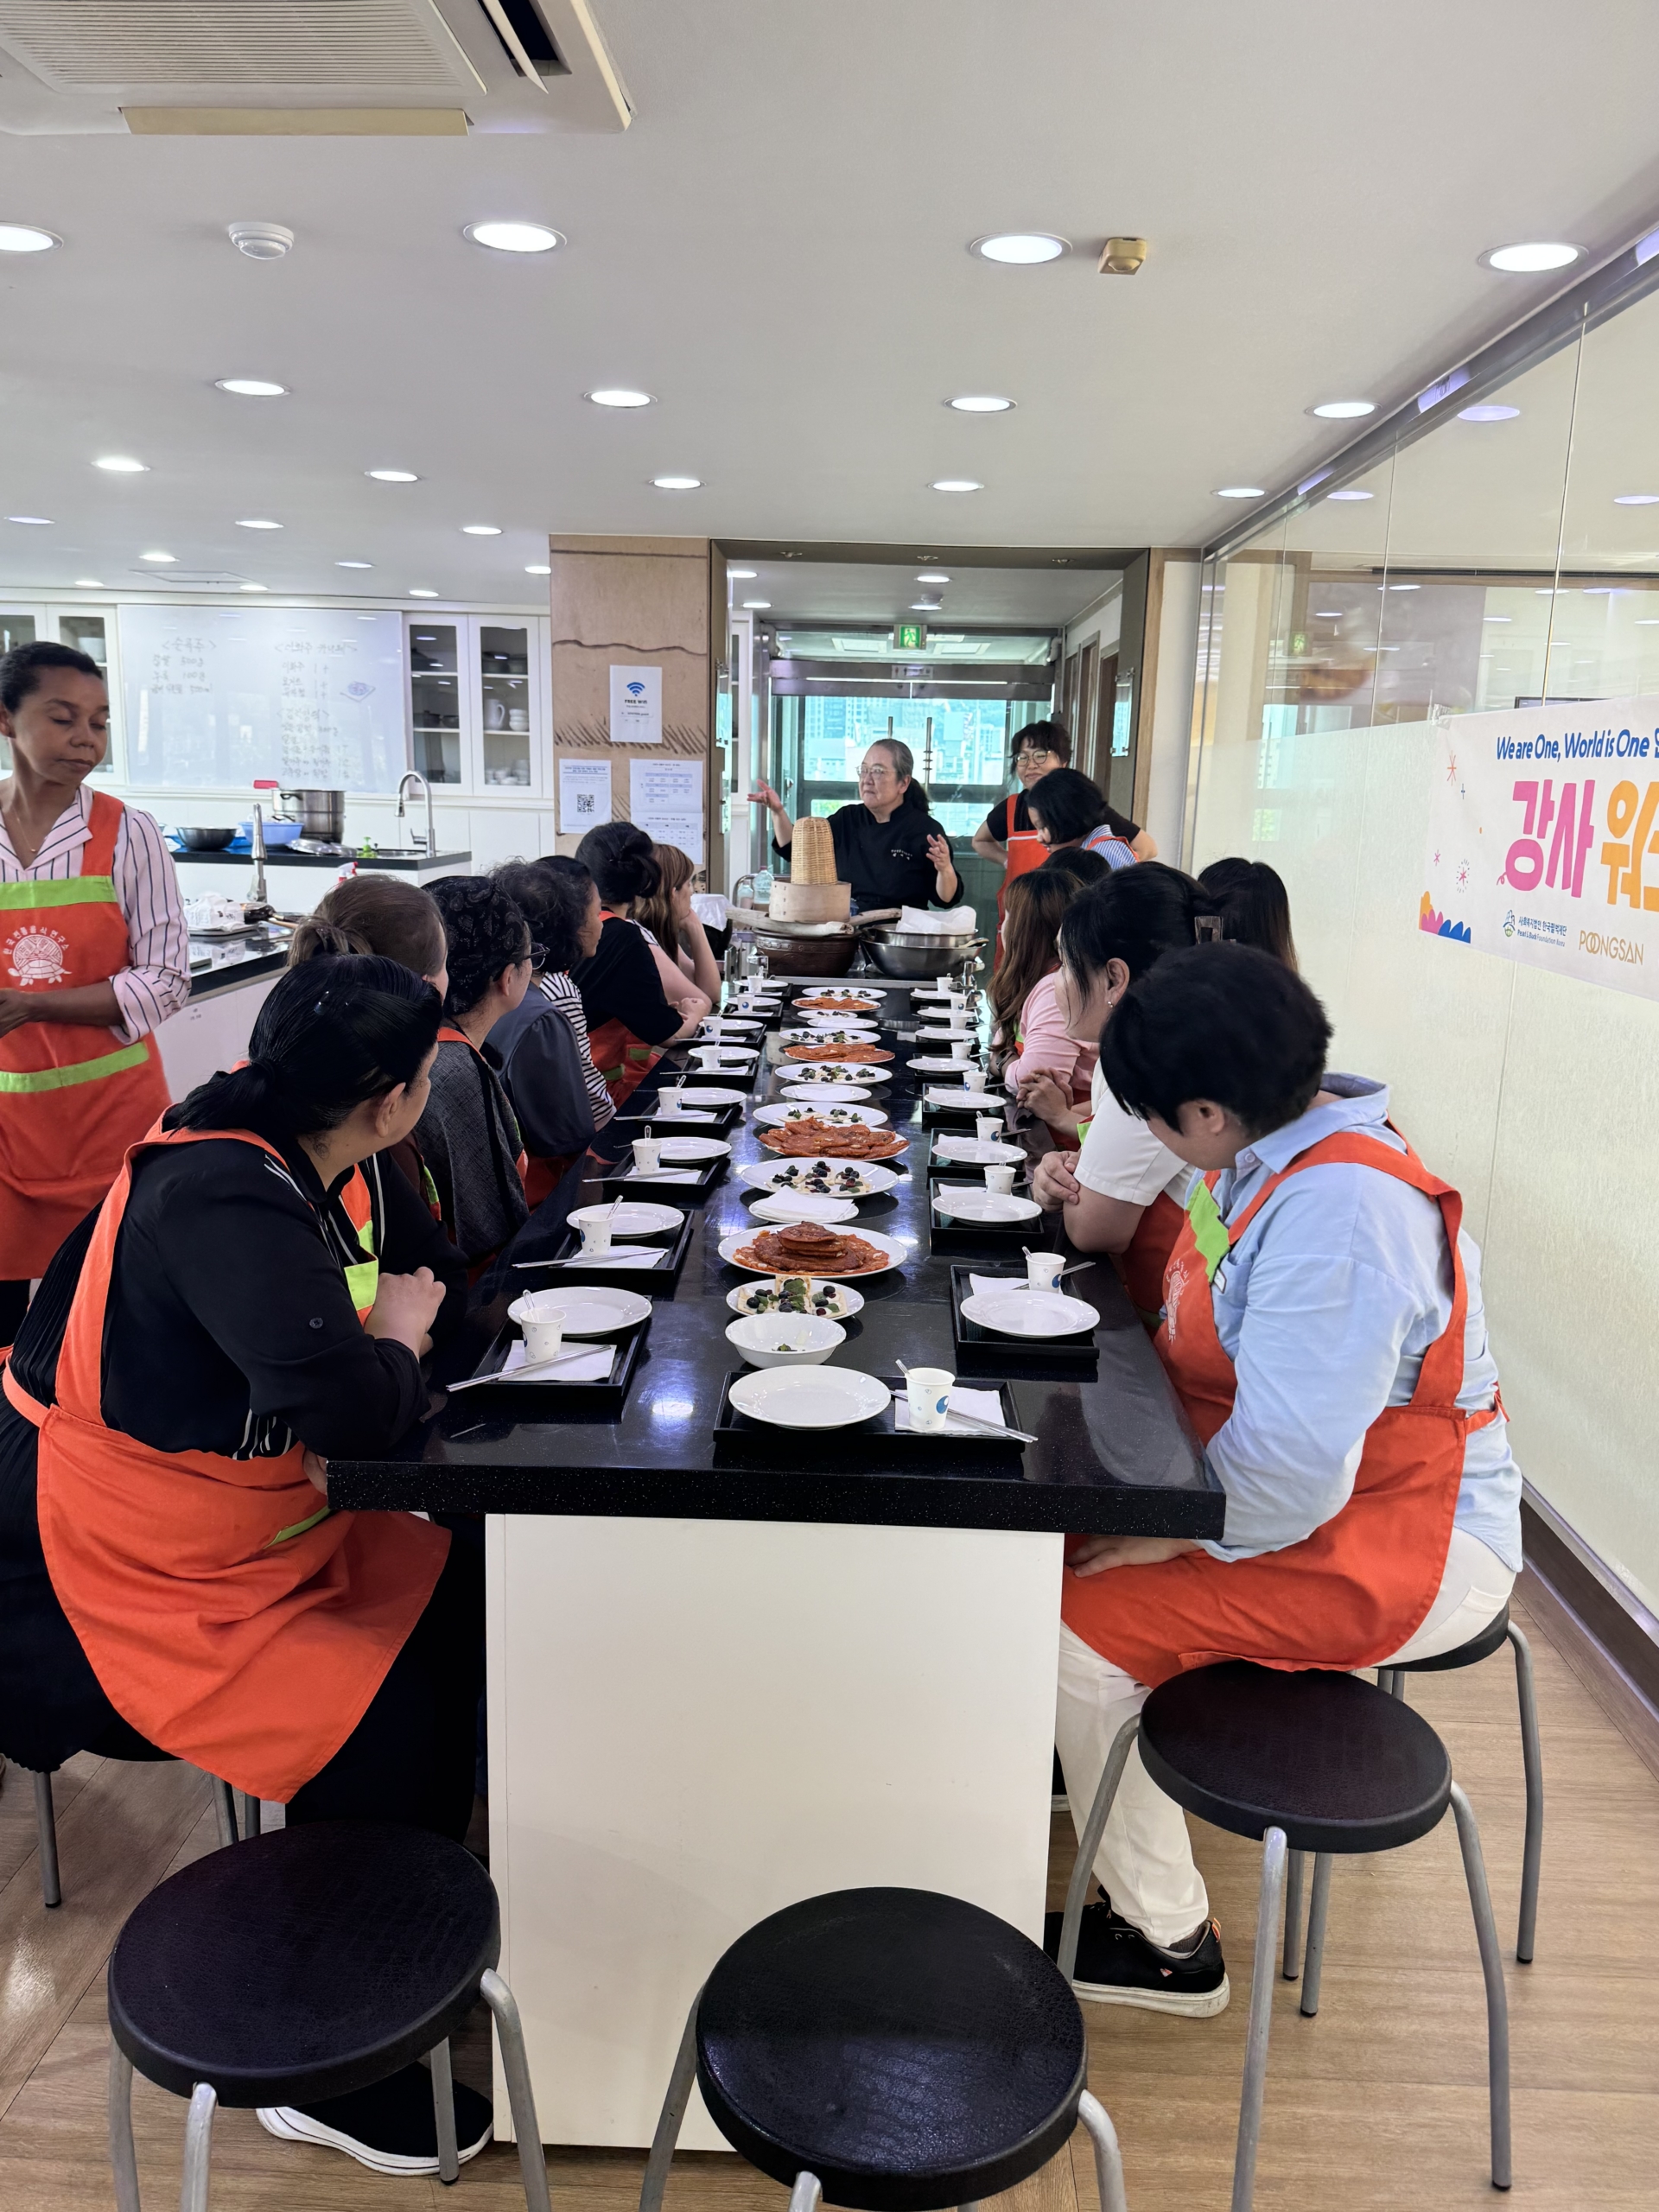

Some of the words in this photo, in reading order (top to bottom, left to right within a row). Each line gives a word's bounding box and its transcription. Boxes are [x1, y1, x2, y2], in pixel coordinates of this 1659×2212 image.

[1497, 735, 1515, 760] We
[1516, 741, 1533, 760] are
[1535, 734, 1560, 762] One,
[1565, 730, 1605, 758] World
[1605, 729, 1615, 758] is
[1616, 728, 1650, 758] One
[1504, 779, 1596, 899] 강사
[1600, 780, 1659, 912] 워
[1579, 930, 1644, 966] POONGSAN
